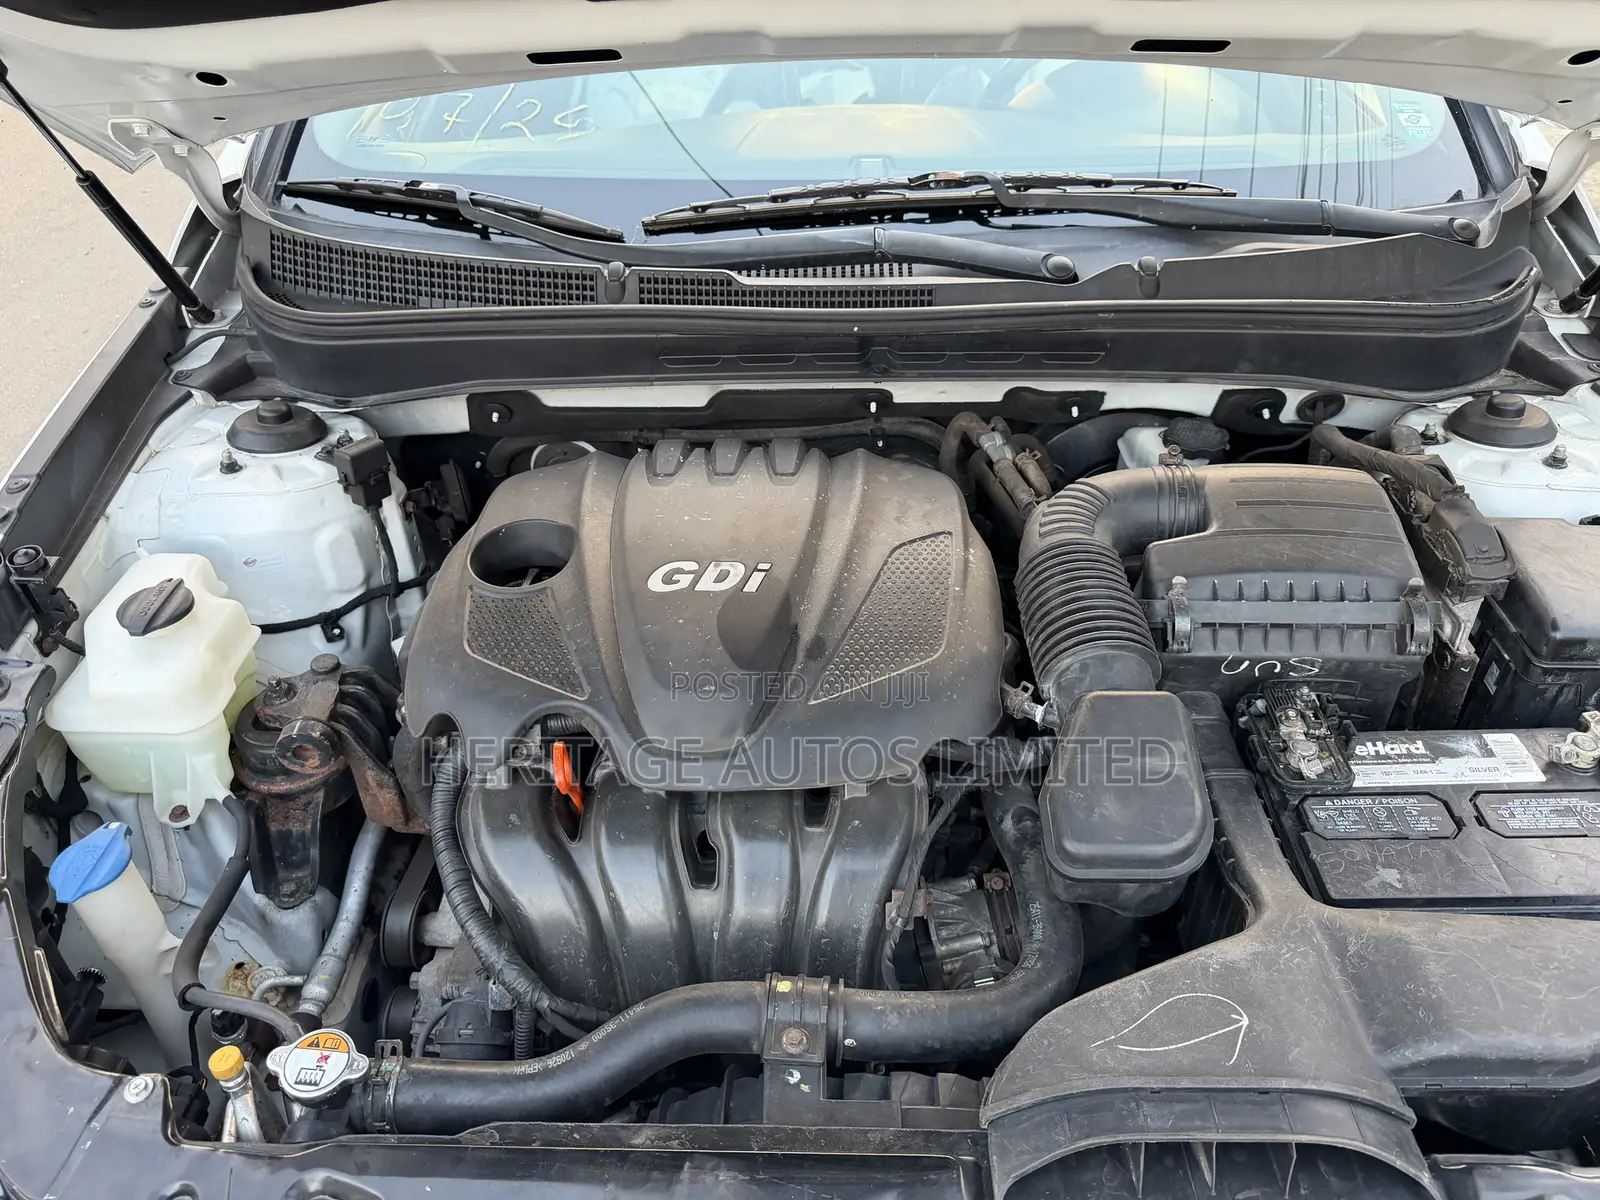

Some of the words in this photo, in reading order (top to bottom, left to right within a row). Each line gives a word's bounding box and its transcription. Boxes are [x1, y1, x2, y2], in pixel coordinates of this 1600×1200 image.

[646, 560, 773, 593] GDi
[139, 584, 168, 617] COOLANT
[1354, 739, 1427, 757] eHard
[1333, 797, 1373, 806] DANGER
[1381, 796, 1418, 805] POISON
[1317, 841, 1432, 875] SONATA
[590, 1002, 647, 1043] 25411-3S000
